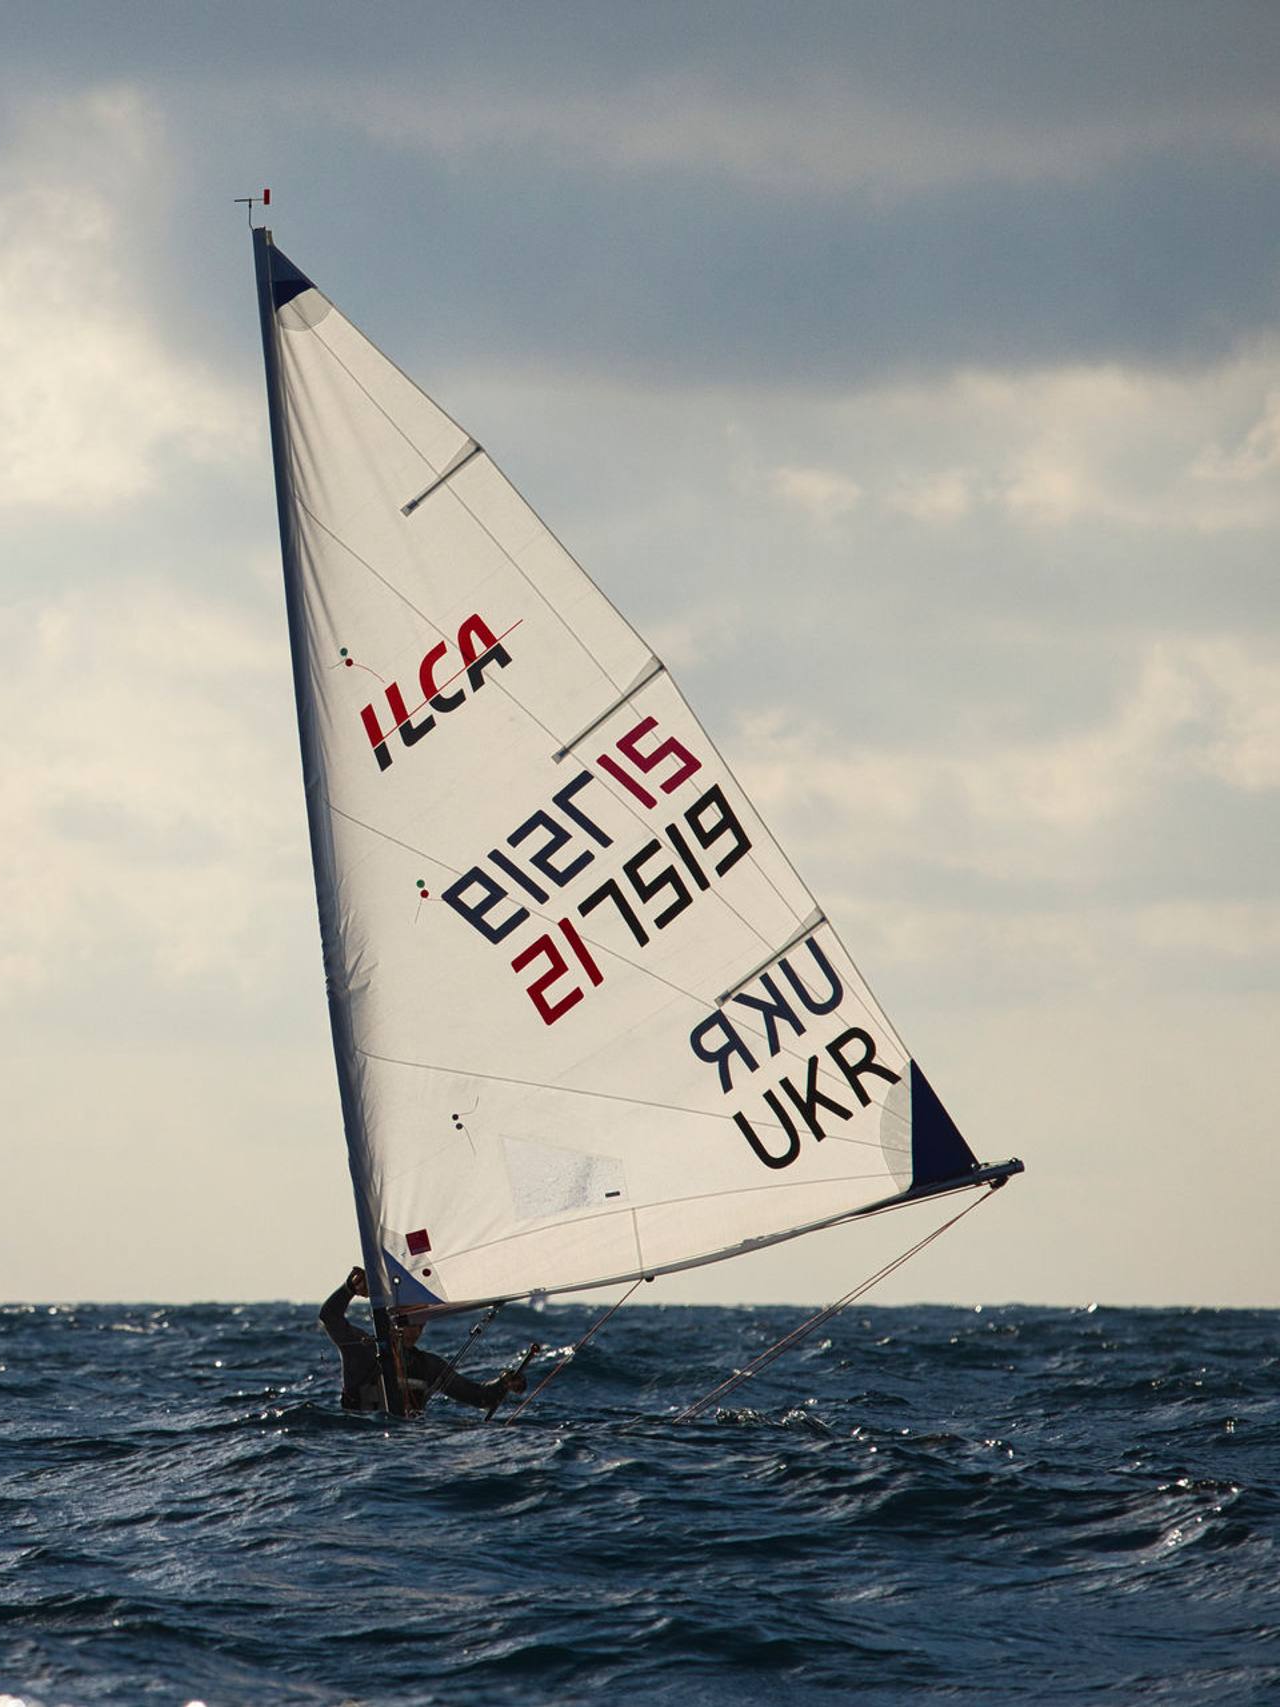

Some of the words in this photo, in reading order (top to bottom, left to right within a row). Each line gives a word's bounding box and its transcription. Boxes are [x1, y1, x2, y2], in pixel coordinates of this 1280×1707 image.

[360, 613, 512, 772] ILCA
[511, 783, 752, 1026] 217519
[732, 1027, 901, 1170] UKR
